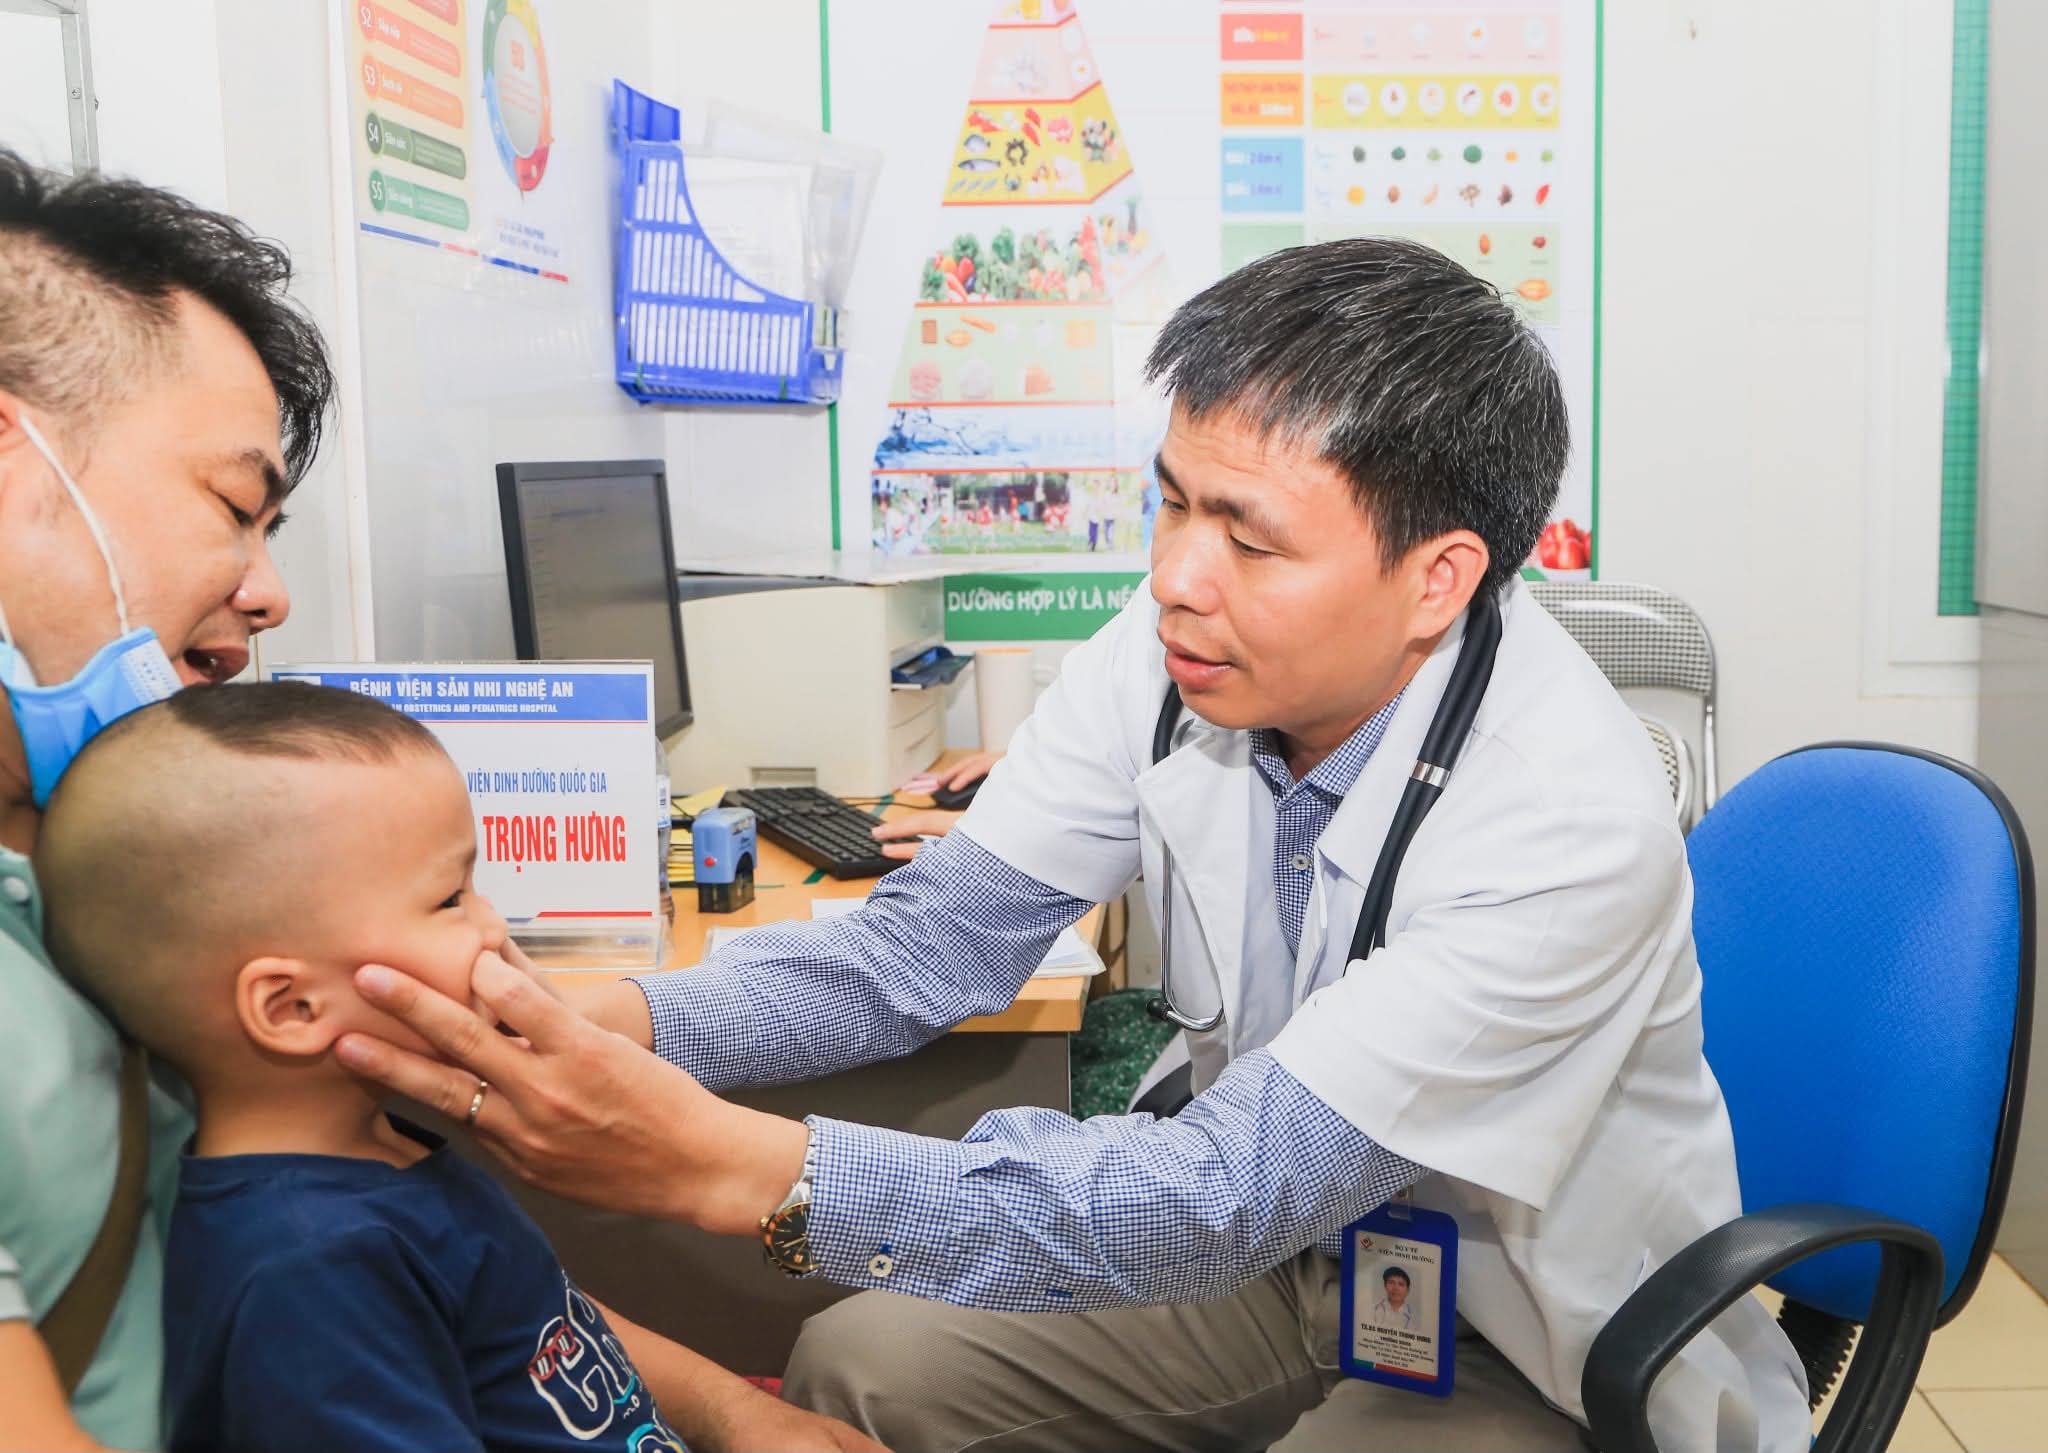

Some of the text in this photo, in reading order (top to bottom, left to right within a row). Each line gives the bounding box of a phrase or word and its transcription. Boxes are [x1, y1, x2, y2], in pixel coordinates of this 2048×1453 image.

[368, 122, 380, 145] S4
[371, 180, 382, 203] S5
[397, 679, 432, 701] VIỆN
[437, 676, 469, 697] SẢN
[474, 681, 501, 697] NHI
[506, 678, 547, 701] NGHỆ
[552, 681, 574, 697] AN
[403, 703, 451, 713] OBSTETRICS
[453, 703, 471, 713] AND
[472, 703, 518, 713] PEDIATRICS
[520, 703, 558, 713] HOSPITAL
[467, 768, 490, 797] VIỆN
[494, 772, 519, 793] DINH
[522, 767, 556, 793] DƯỠNG
[590, 772, 607, 793] GIA
[482, 811, 626, 872] TRỌNG HƯNG
